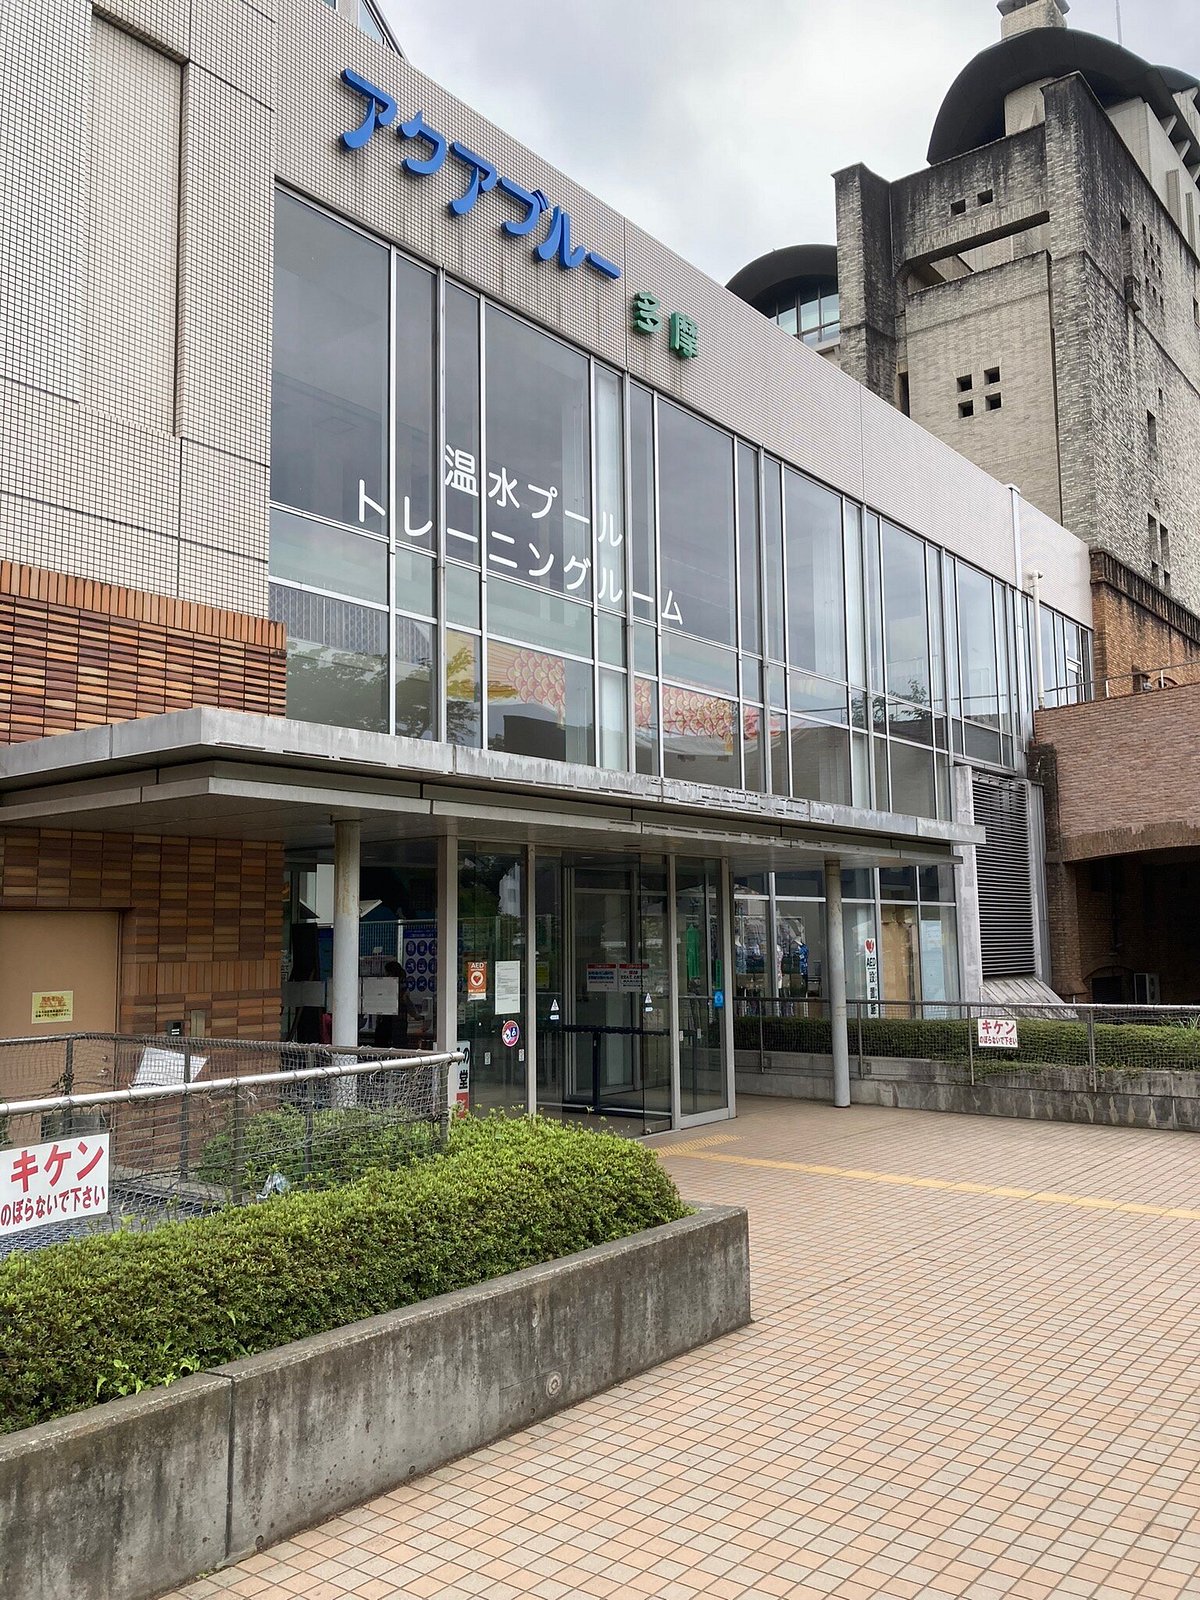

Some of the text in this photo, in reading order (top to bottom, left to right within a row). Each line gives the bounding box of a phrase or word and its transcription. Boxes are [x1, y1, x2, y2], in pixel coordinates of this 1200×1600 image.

[340, 67, 621, 279] アクアブルー
[633, 291, 698, 359] 多摩
[445, 444, 623, 547] 温水プール
[359, 479, 684, 626] トレーニングルーム
[982, 1020, 1015, 1035] キケン
[10, 1141, 105, 1193] キケン
[0, 1185, 106, 1226] のぼらないで下さい
